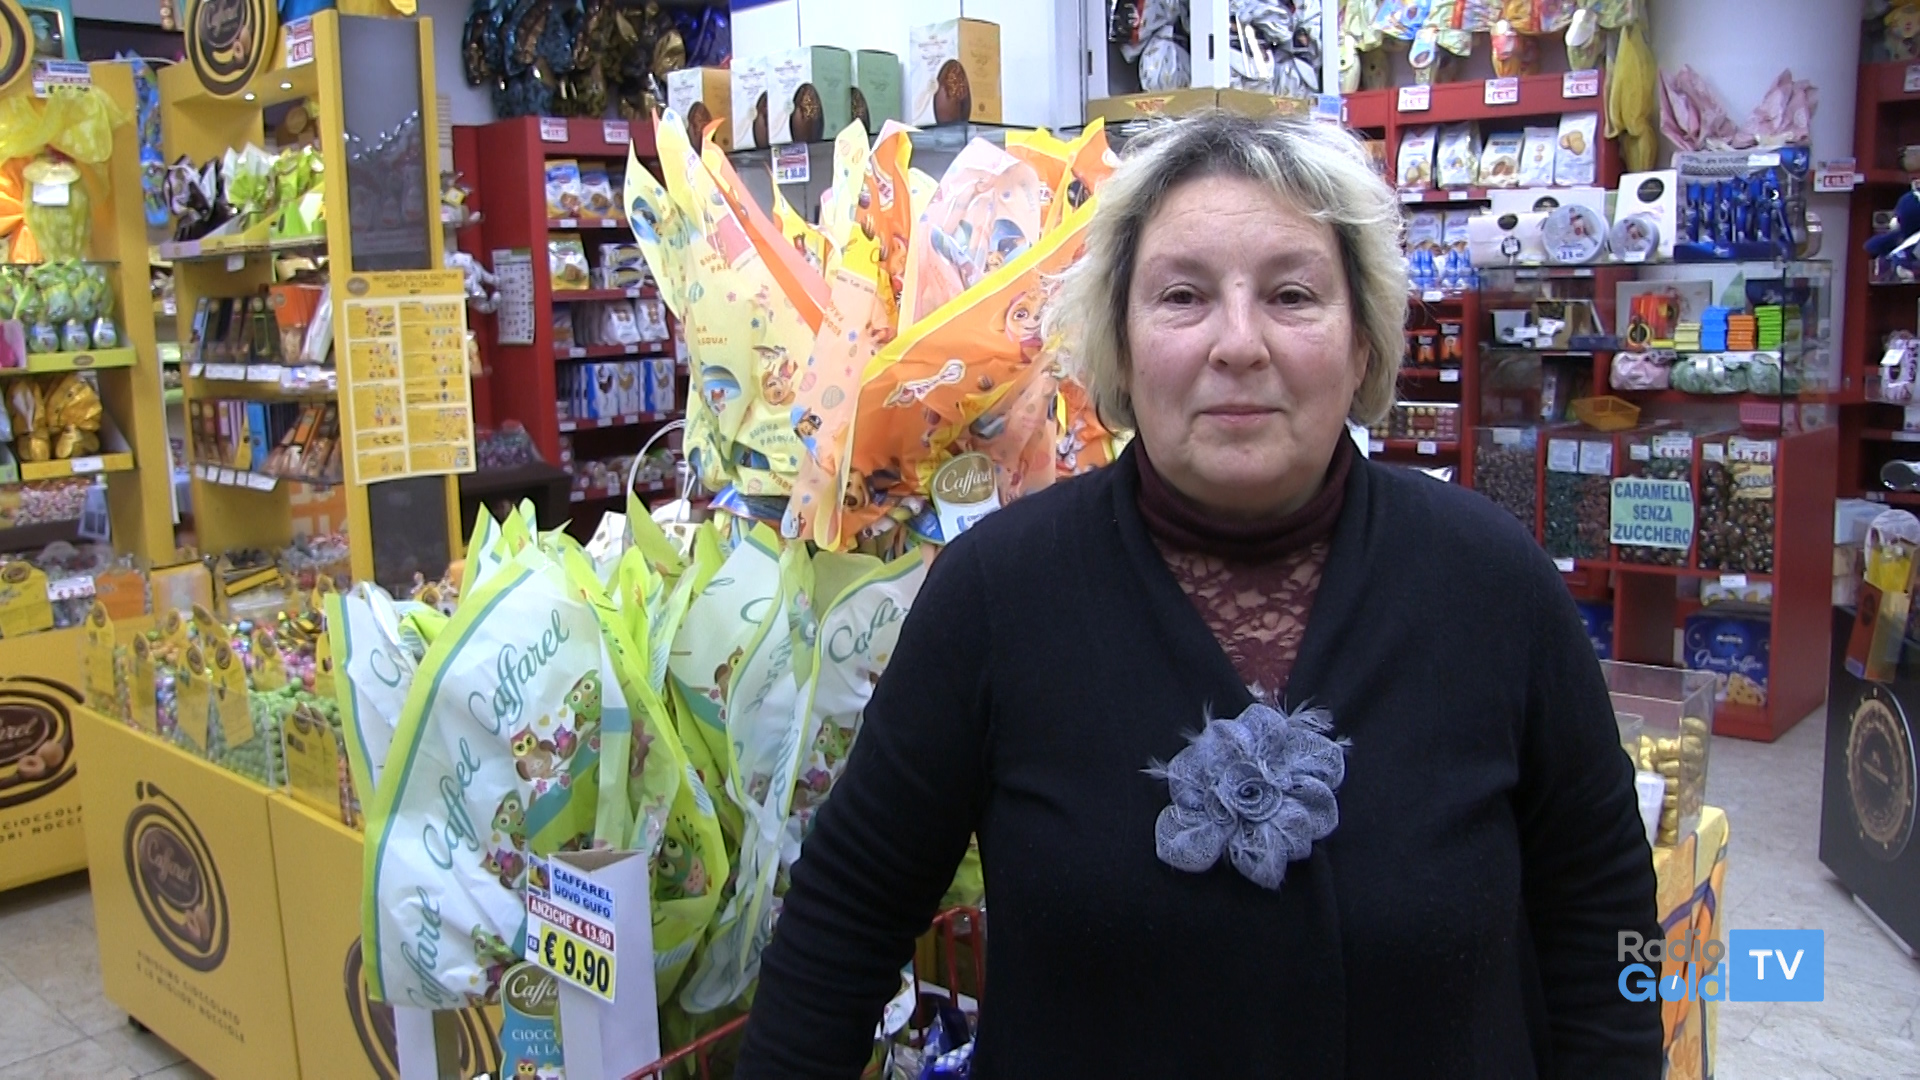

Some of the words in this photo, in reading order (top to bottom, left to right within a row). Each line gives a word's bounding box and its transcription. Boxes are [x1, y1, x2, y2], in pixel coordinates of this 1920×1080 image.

[1633, 504, 1673, 522] SENZA
[1613, 523, 1690, 544] ZUCCHERO
[469, 609, 570, 736] Caffarel
[554, 867, 612, 903] CAFFAREL
[554, 883, 581, 904] UOVO
[583, 897, 611, 919] GUFO
[531, 899, 575, 929] ANZICHE'
[576, 919, 583, 934] €
[586, 924, 611, 948] 13.90
[545, 931, 557, 967] €
[564, 939, 610, 992] 9.90
[511, 974, 558, 1008] Caffa
[512, 1028, 557, 1041] CIOCC
